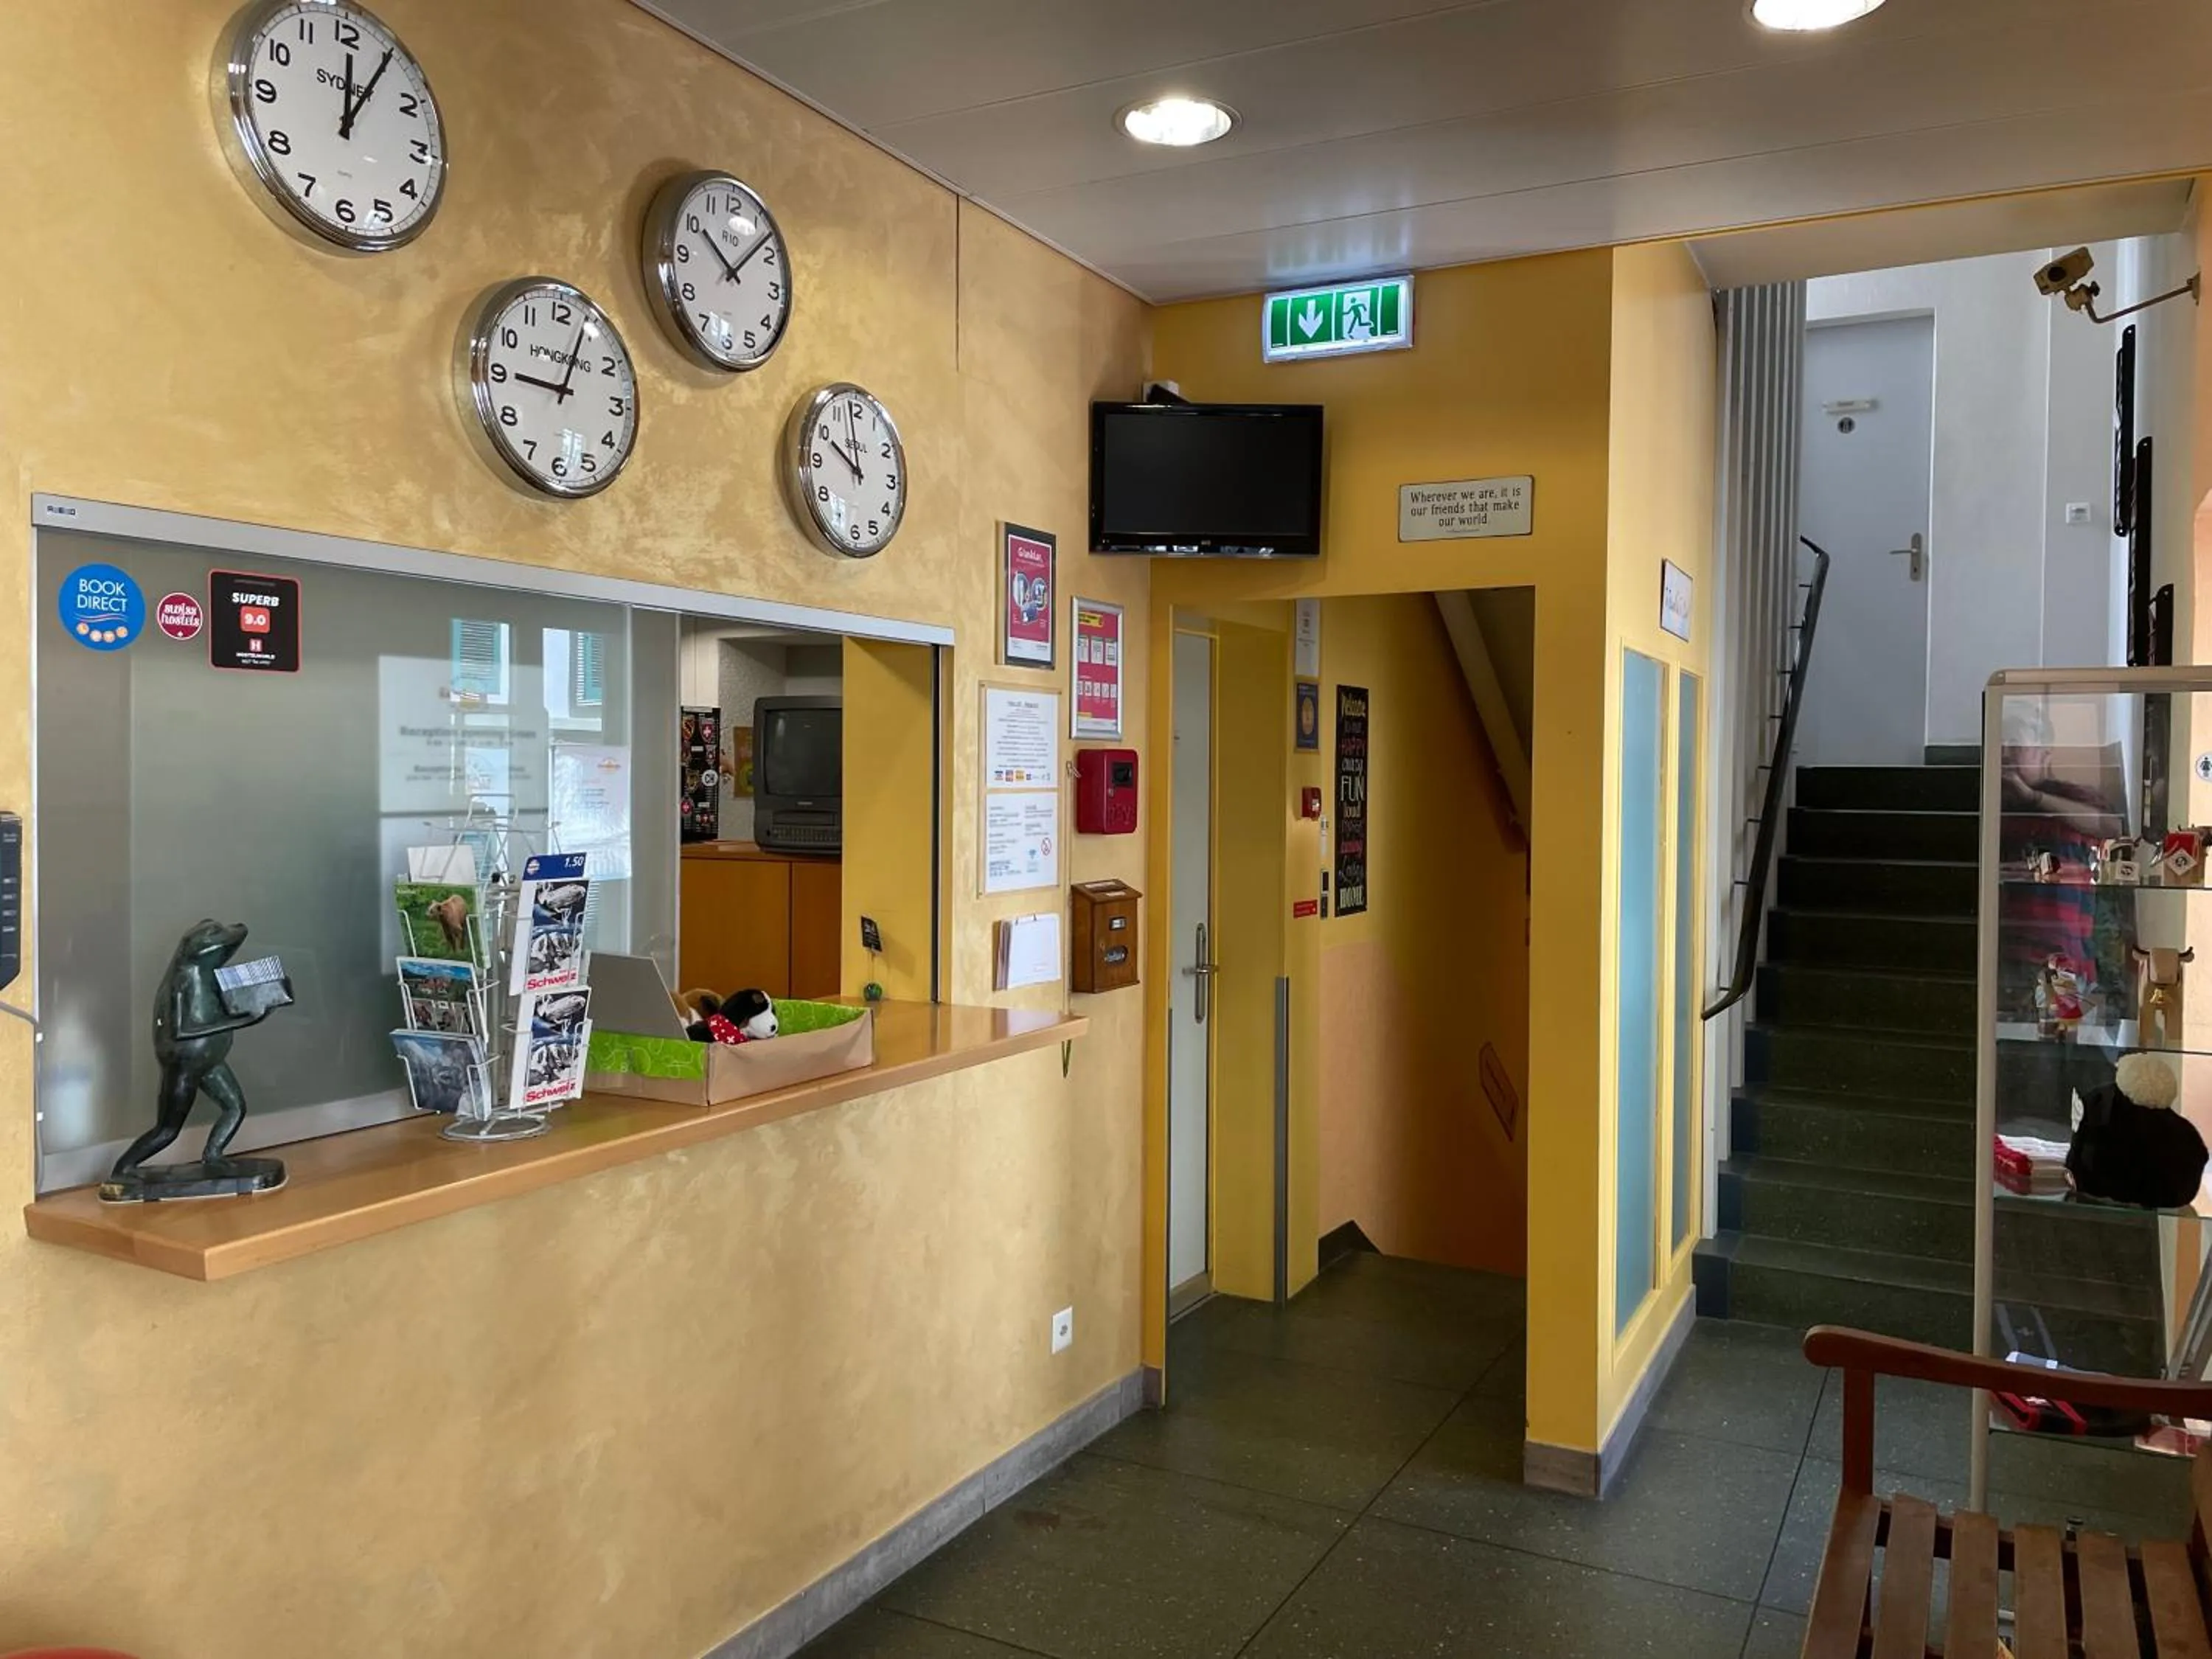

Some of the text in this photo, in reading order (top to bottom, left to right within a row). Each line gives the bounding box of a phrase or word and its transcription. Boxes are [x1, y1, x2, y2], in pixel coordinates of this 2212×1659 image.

[299, 19, 313, 44] 11
[335, 20, 359, 50] 12
[270, 39, 291, 66] 10
[256, 80, 277, 103] 9
[400, 93, 417, 117] 2
[268, 131, 291, 156] 8
[409, 139, 428, 164] 3
[297, 173, 316, 198] 7
[399, 178, 417, 200] 4
[335, 199, 355, 223] 6
[373, 199, 393, 222] 5
[706, 194, 715, 215] 11
[726, 194, 742, 215] 12
[686, 213, 700, 233] 10
[676, 245, 689, 262] 9
[764, 247, 775, 265] 2
[682, 283, 695, 301] 8
[768, 282, 779, 300] 3
[525, 305, 535, 327] 11
[552, 302, 571, 325] 12
[698, 314, 710, 332] 7
[761, 314, 771, 330] 4
[501, 327, 518, 349] 10
[744, 330, 756, 349] 5
[491, 364, 507, 383] 9
[602, 357, 616, 378] 2
[501, 406, 518, 426] 8
[609, 397, 624, 417] 3
[601, 431, 615, 449] 4
[819, 424, 830, 441] 10
[523, 439, 537, 460] 7
[882, 443, 891, 459] 2
[552, 457, 568, 477] 6
[581, 453, 596, 473] 5
[813, 453, 822, 468] 9
[886, 474, 896, 490] 3
[818, 486, 829, 501] 8
[1411, 490, 1457, 503] Wherever
[1461, 490, 1474, 500] we
[1500, 486, 1508, 497] it
[1513, 485, 1521, 496] is
[882, 501, 891, 516] 4
[1411, 500, 1520, 516] our friends that make
[869, 521, 878, 535] 5
[1439, 513, 1487, 526] our world
[851, 525, 860, 540] 6
[79, 579, 126, 597] BOOK
[77, 594, 128, 613] DIRECT
[232, 592, 279, 607] SUPERB
[1340, 775, 1365, 801] FUN
[565, 856, 584, 867] 1.50
[527, 970, 577, 990] Schweiz
[526, 1080, 575, 1102] Schweiz
